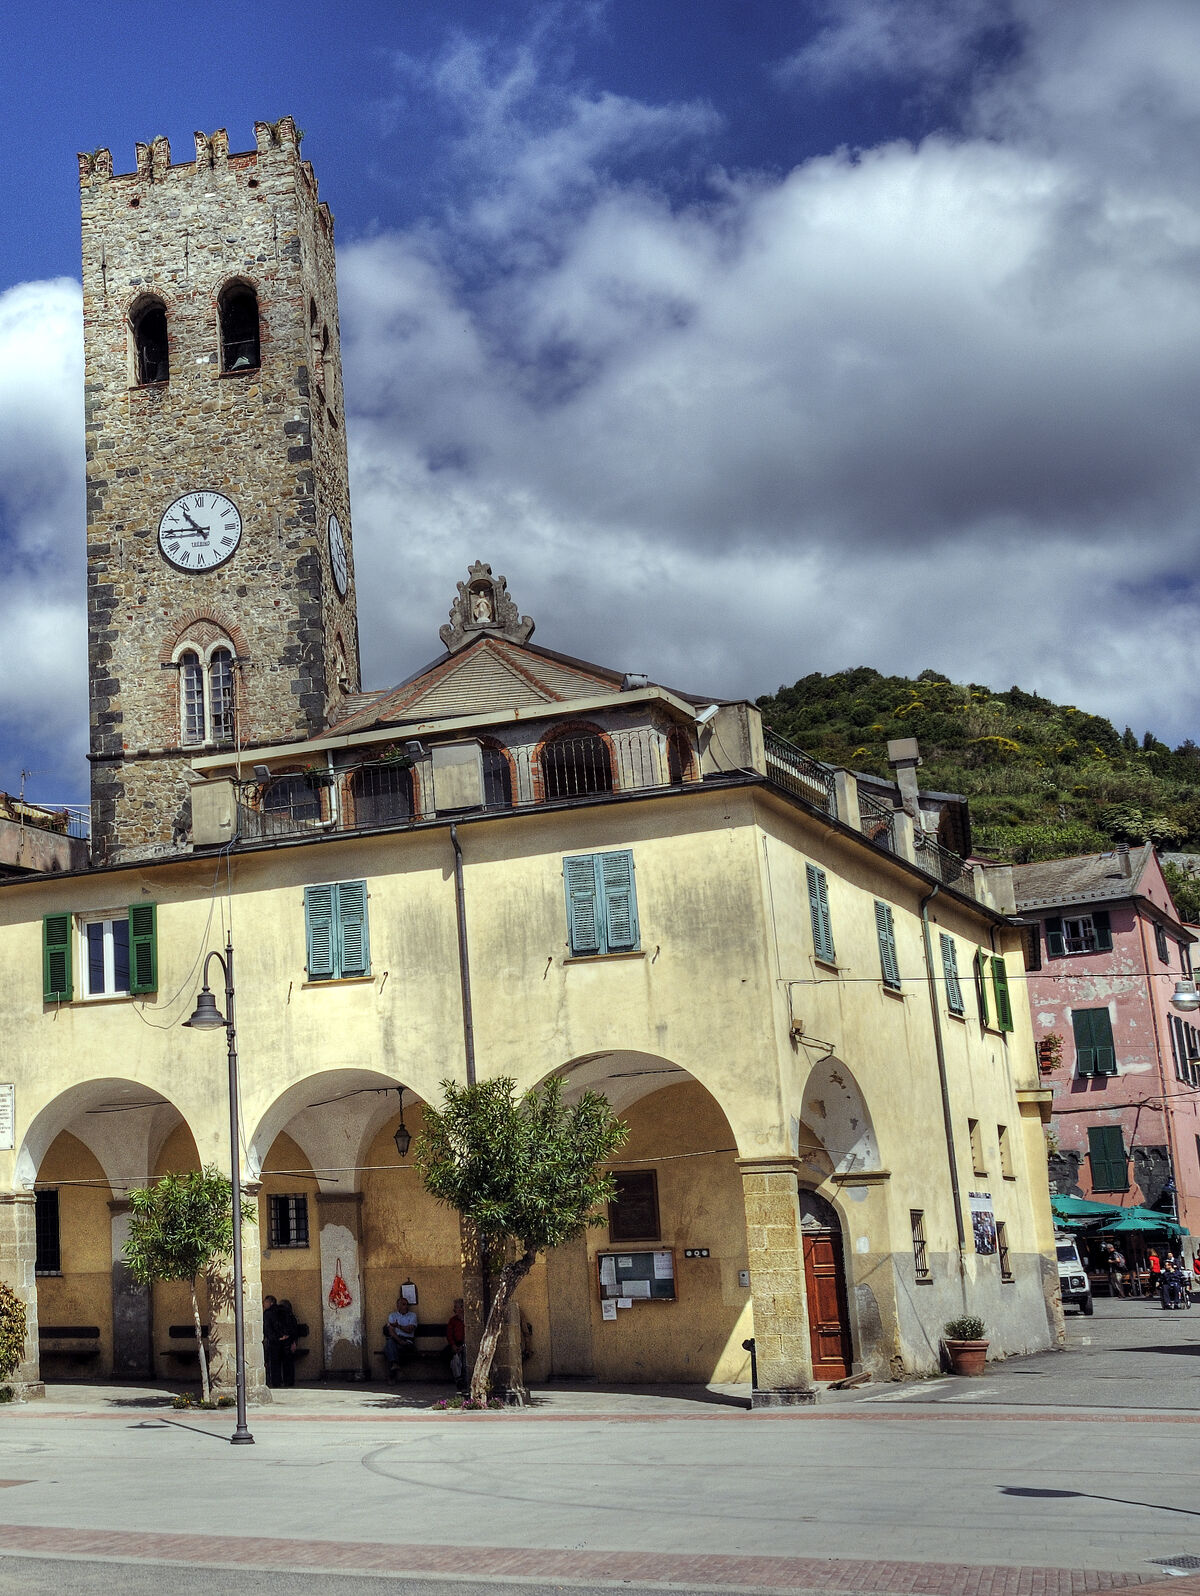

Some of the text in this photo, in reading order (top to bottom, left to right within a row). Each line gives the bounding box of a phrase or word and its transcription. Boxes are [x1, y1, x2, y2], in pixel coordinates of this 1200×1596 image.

[195, 497, 204, 508] XII
[211, 499, 218, 509] I
[220, 508, 231, 518] II
[168, 515, 180, 524] X
[224, 523, 236, 531] III
[220, 536, 233, 547] IIII
[168, 541, 180, 555] VIII
[180, 551, 190, 563] VII
[198, 553, 205, 564] VI
[213, 549, 221, 559] V
